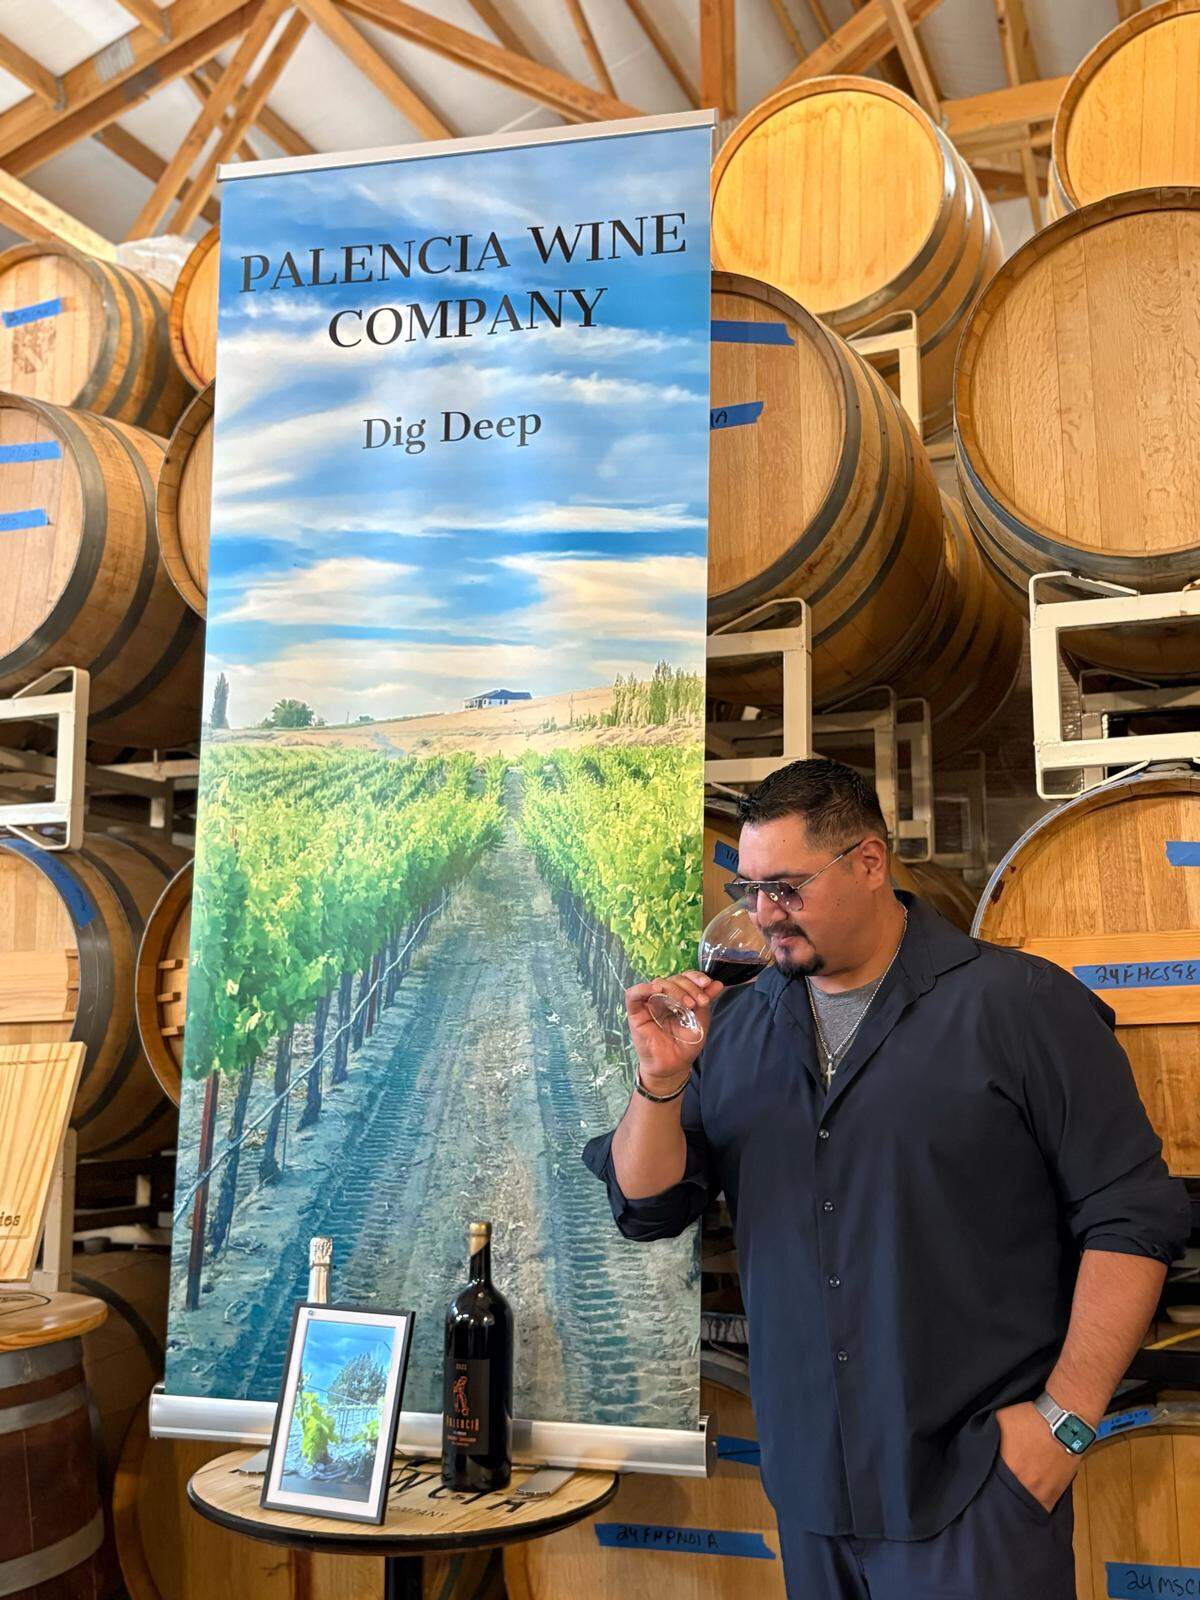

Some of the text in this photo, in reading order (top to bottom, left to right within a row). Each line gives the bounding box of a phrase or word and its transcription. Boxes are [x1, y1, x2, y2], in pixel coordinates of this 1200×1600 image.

[239, 212, 687, 293] PALENCIA WINE
[328, 287, 608, 348] COMPANY
[362, 410, 542, 455] Dig Deep
